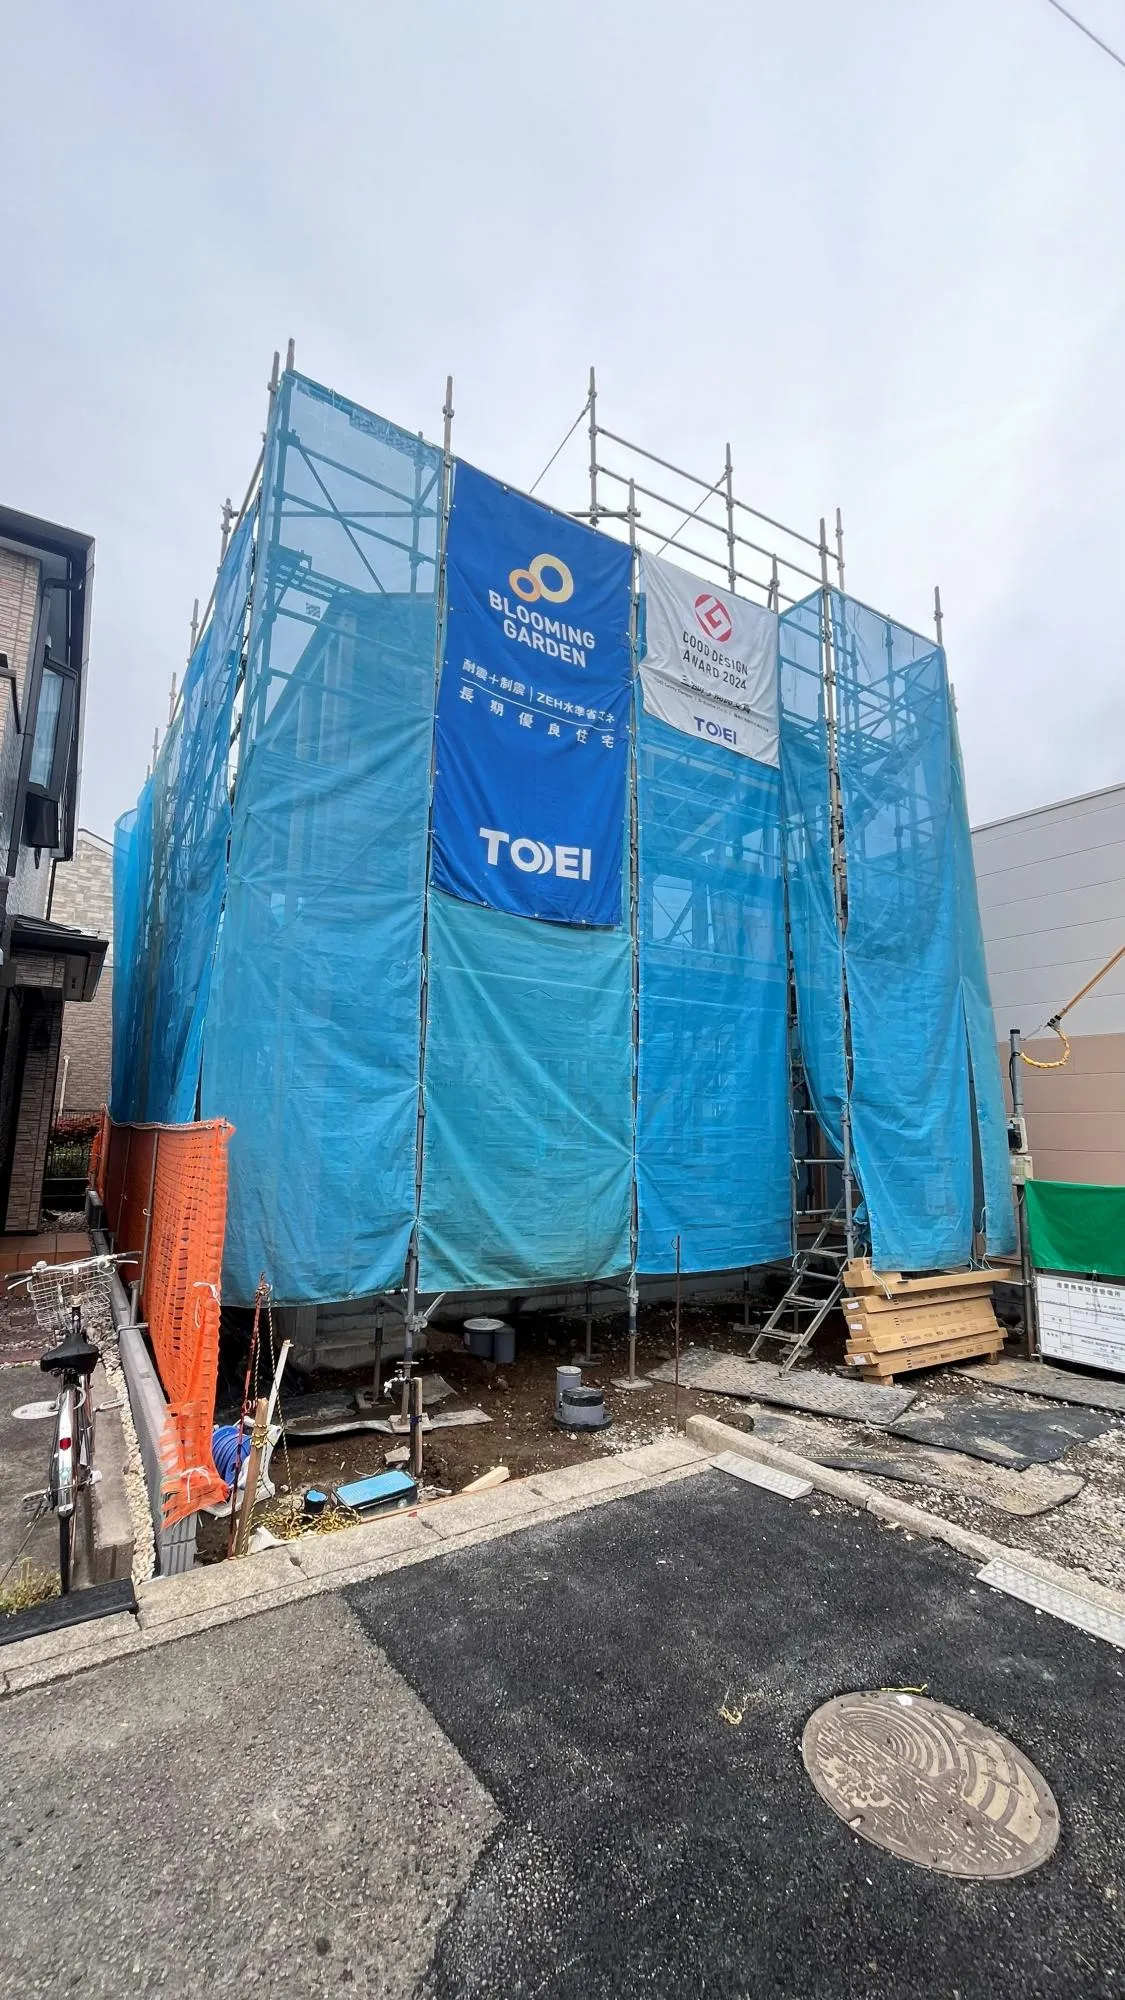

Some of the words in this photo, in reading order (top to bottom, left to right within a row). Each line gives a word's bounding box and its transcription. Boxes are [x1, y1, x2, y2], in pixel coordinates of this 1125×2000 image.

[488, 589, 596, 650] BLOOMING
[503, 619, 587, 669] GARDEN
[711, 649, 749, 676] DESIGN
[722, 670, 747, 691] 2024
[459, 686, 615, 749] 長期優良住宅
[693, 715, 738, 746] TOEI
[479, 827, 592, 881] TOEI
